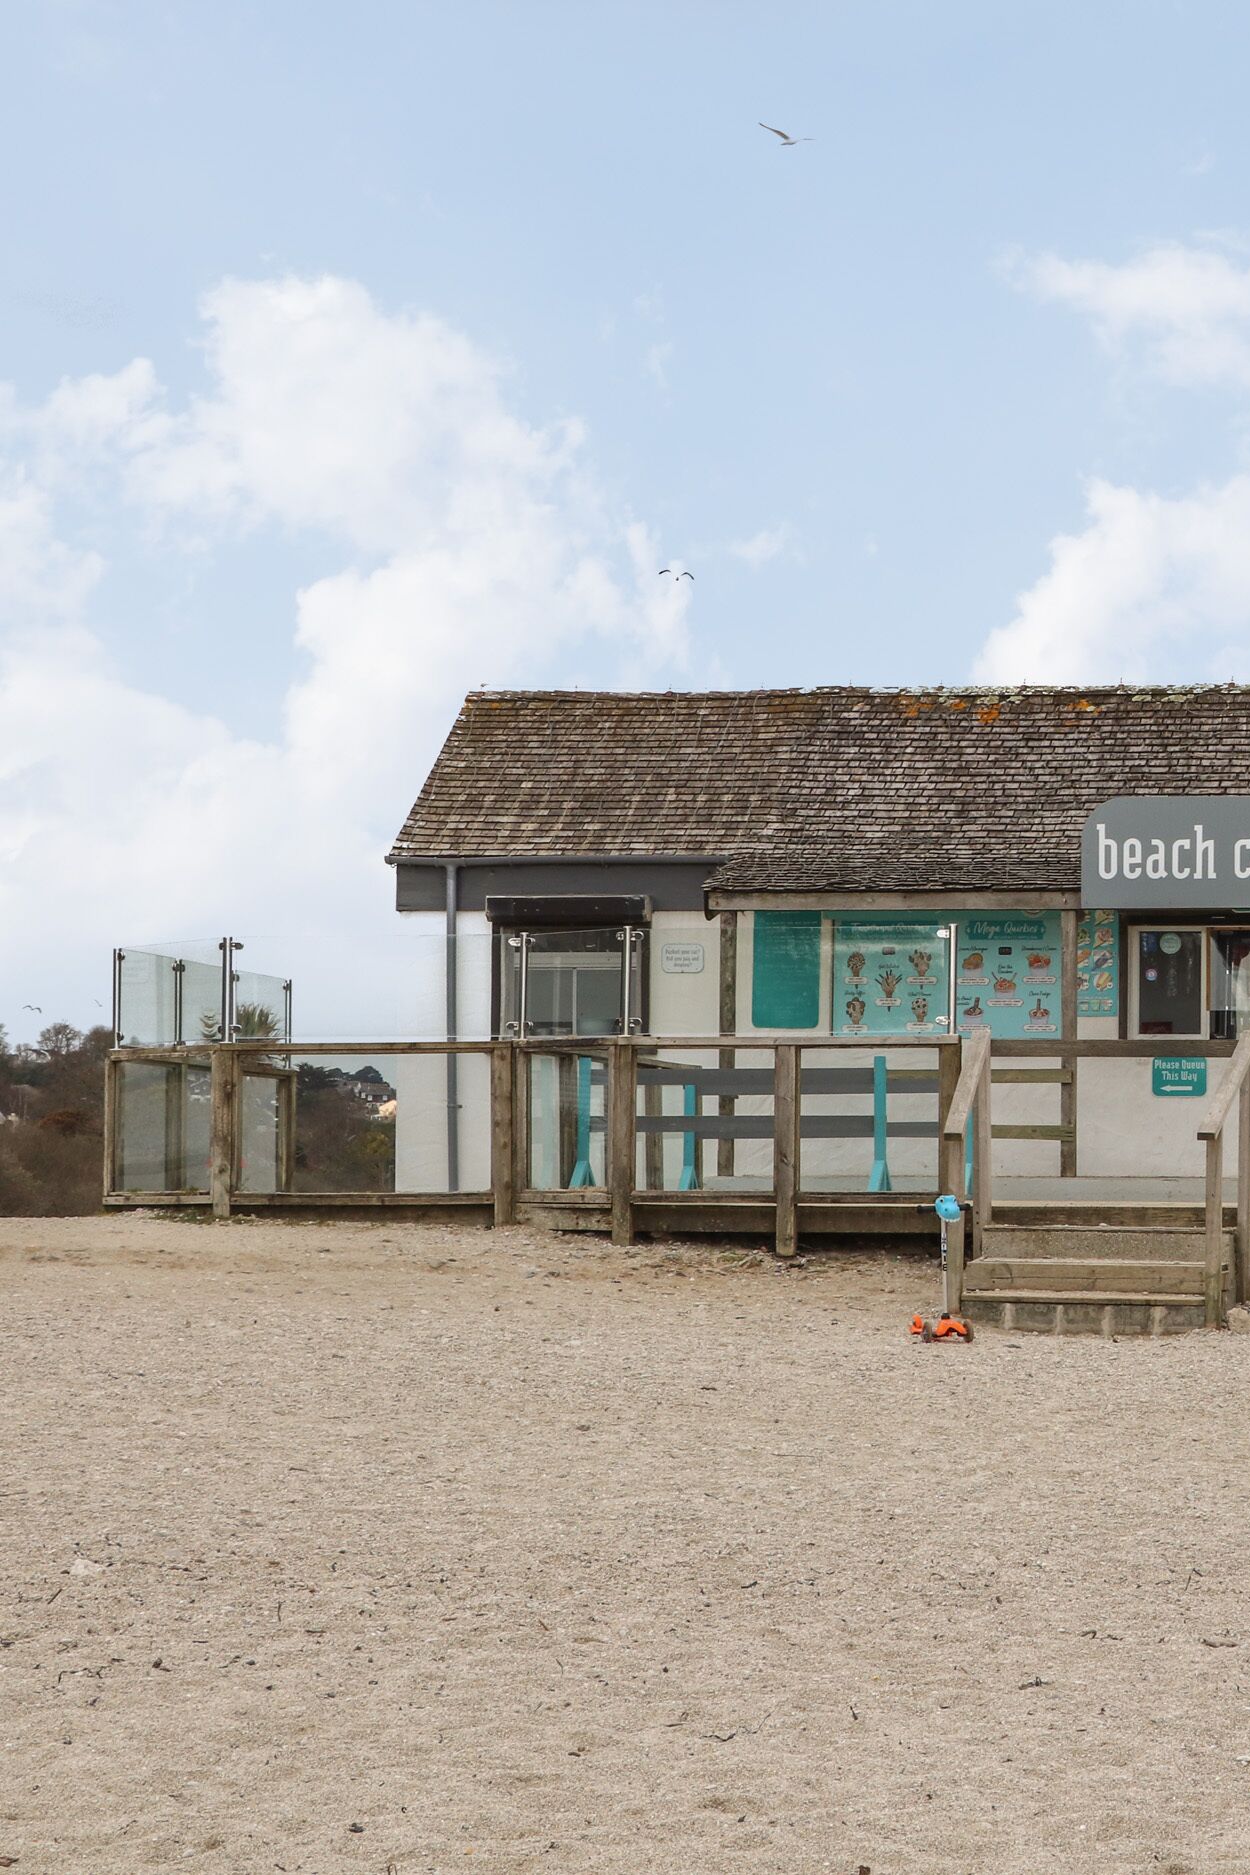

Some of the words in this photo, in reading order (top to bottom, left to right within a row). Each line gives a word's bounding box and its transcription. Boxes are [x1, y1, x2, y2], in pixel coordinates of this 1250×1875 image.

[1096, 823, 1217, 880] beach
[972, 921, 1000, 939] Mega
[1154, 1059, 1180, 1069] Please
[1181, 1059, 1206, 1069] Queue
[1161, 1070, 1179, 1080] This
[1180, 1070, 1198, 1082] Way
